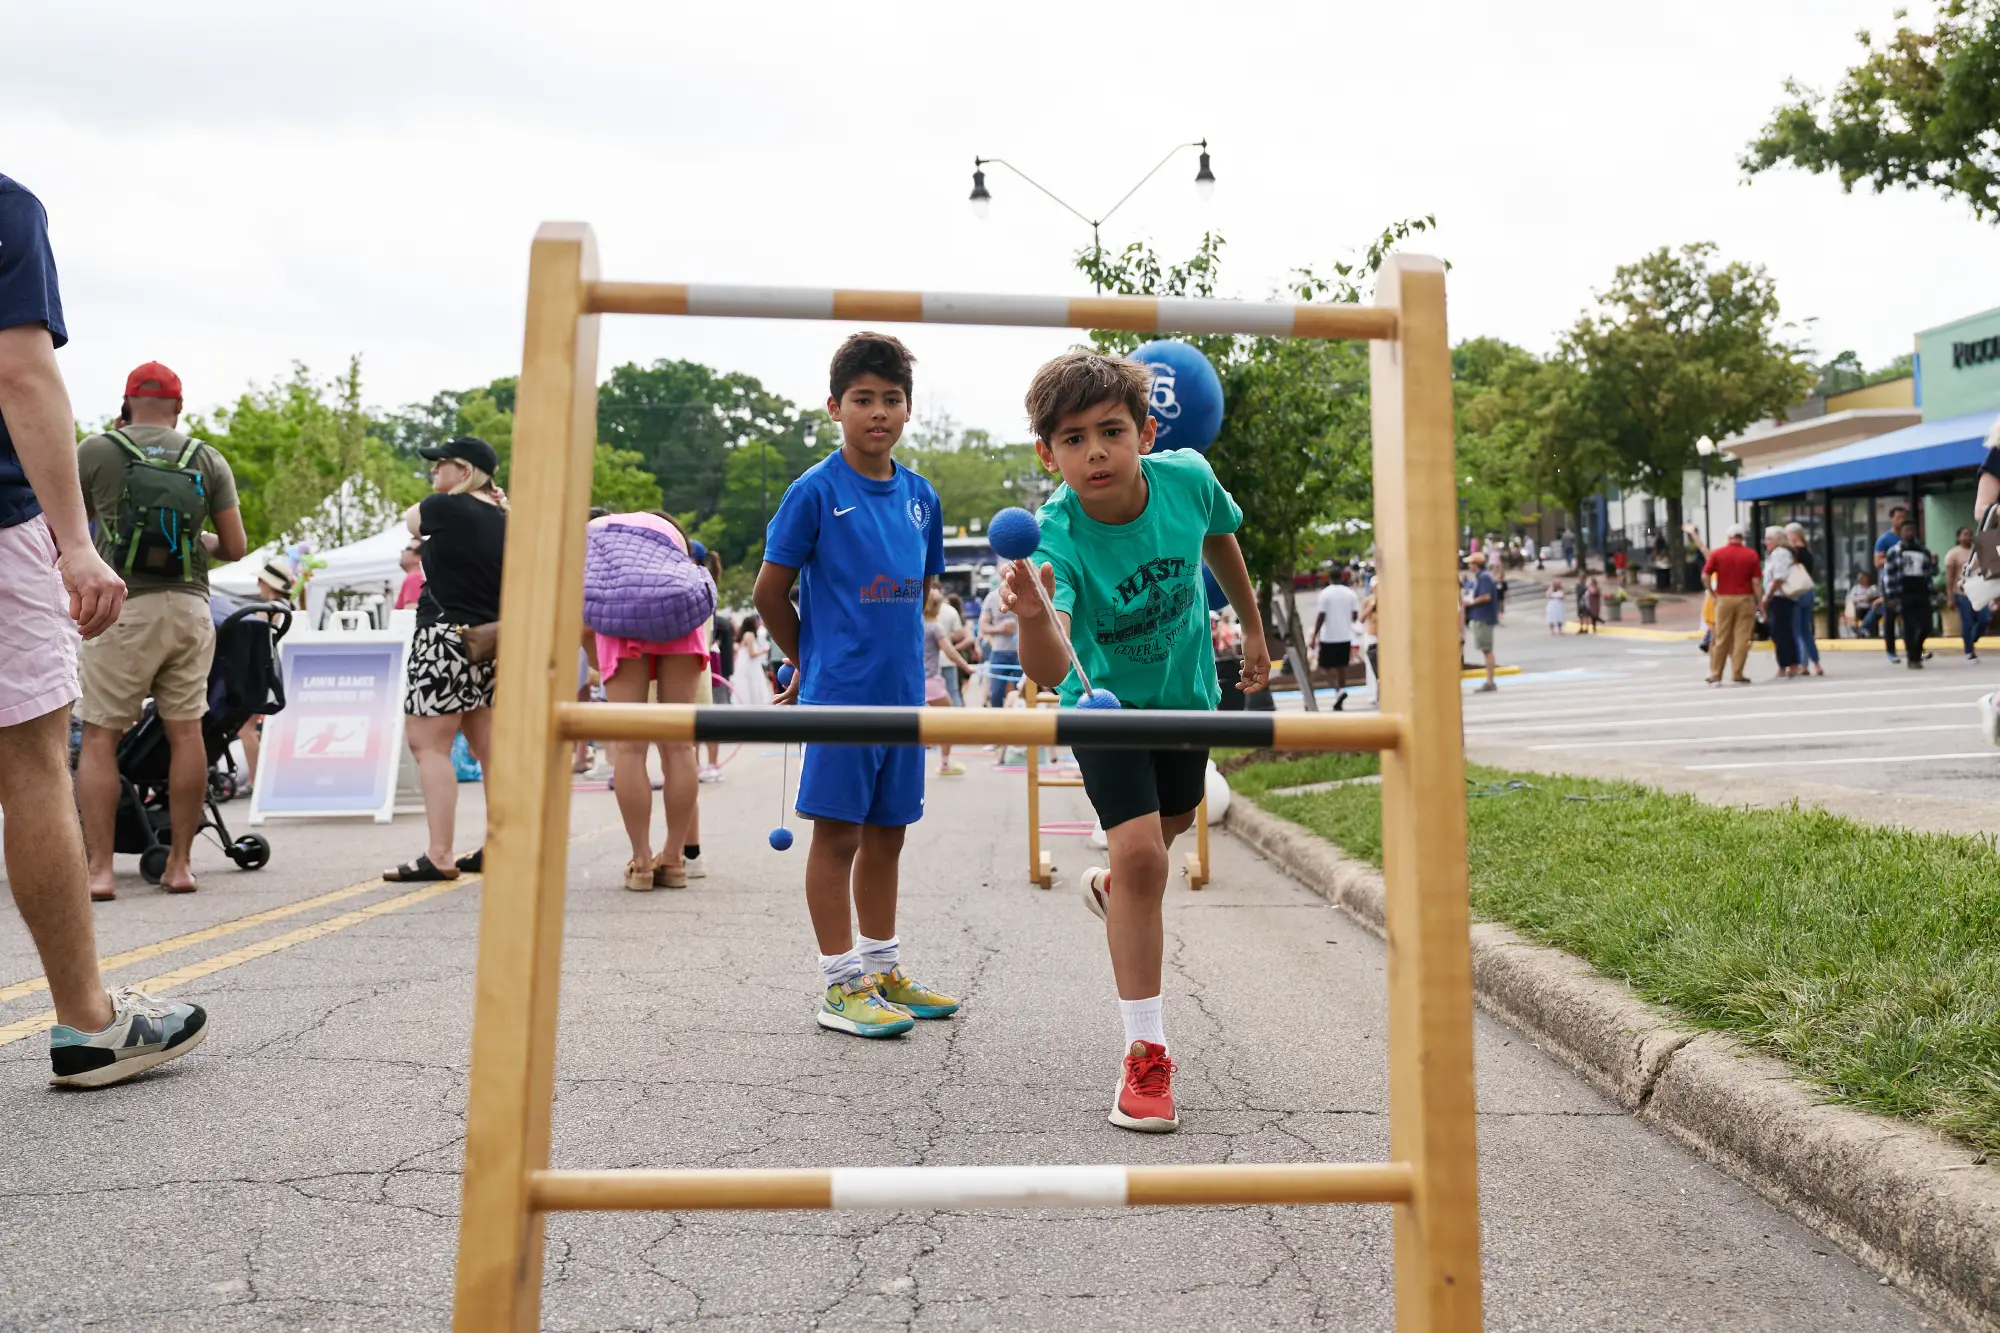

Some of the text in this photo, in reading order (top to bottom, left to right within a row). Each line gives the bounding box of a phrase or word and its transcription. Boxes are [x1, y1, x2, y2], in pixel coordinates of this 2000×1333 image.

[1116, 558, 1185, 605] MAST
[861, 585, 891, 599] RED
[1114, 639, 1162, 657] GENERAL
[303, 676, 336, 688] LAWN
